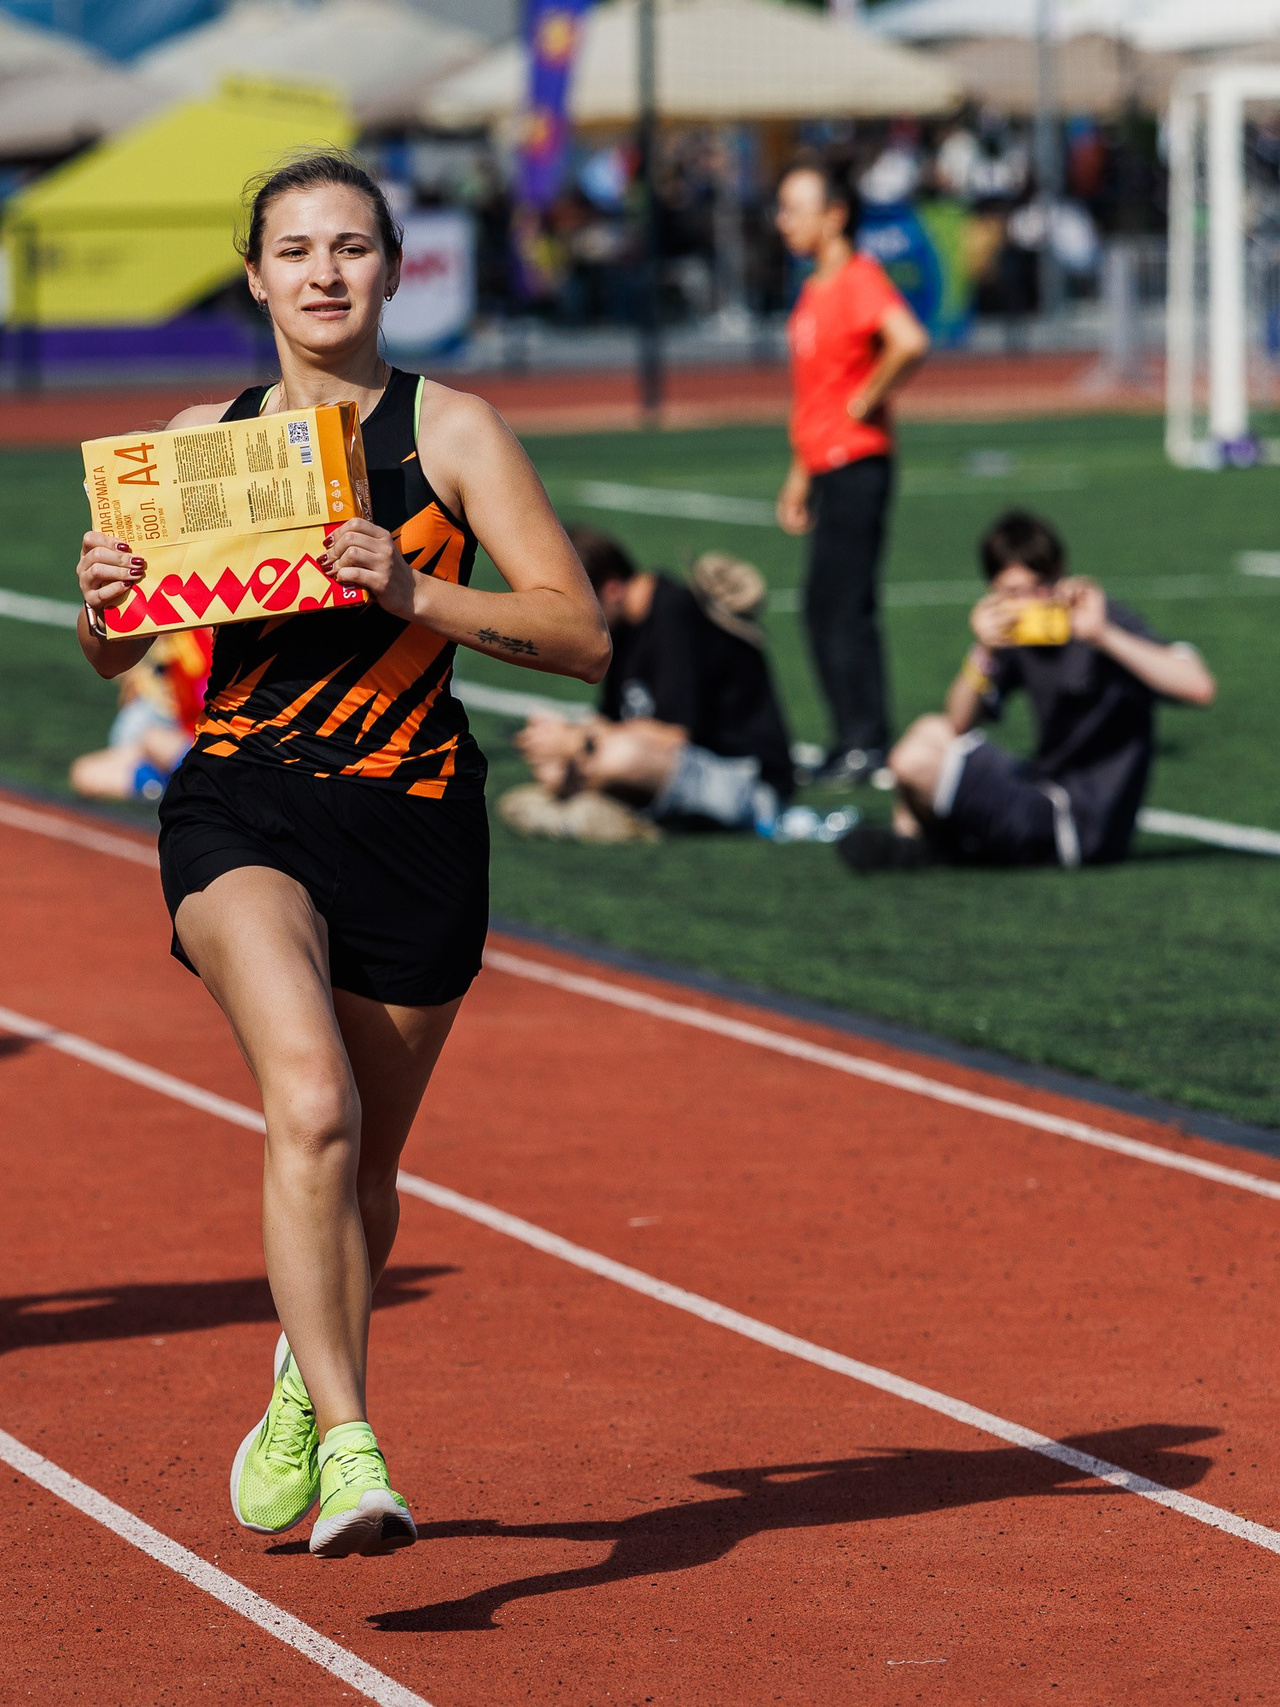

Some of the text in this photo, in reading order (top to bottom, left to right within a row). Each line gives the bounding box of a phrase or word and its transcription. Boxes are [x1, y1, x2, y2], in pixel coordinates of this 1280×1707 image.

[113, 442, 160, 486] A4
[93, 465, 115, 538] ЛАЯ БУМАГА
[112, 499, 124, 531] ОФИСНОЙ
[140, 498, 160, 540] 500 Л.
[124, 515, 135, 543] ТЕХНИКИ
